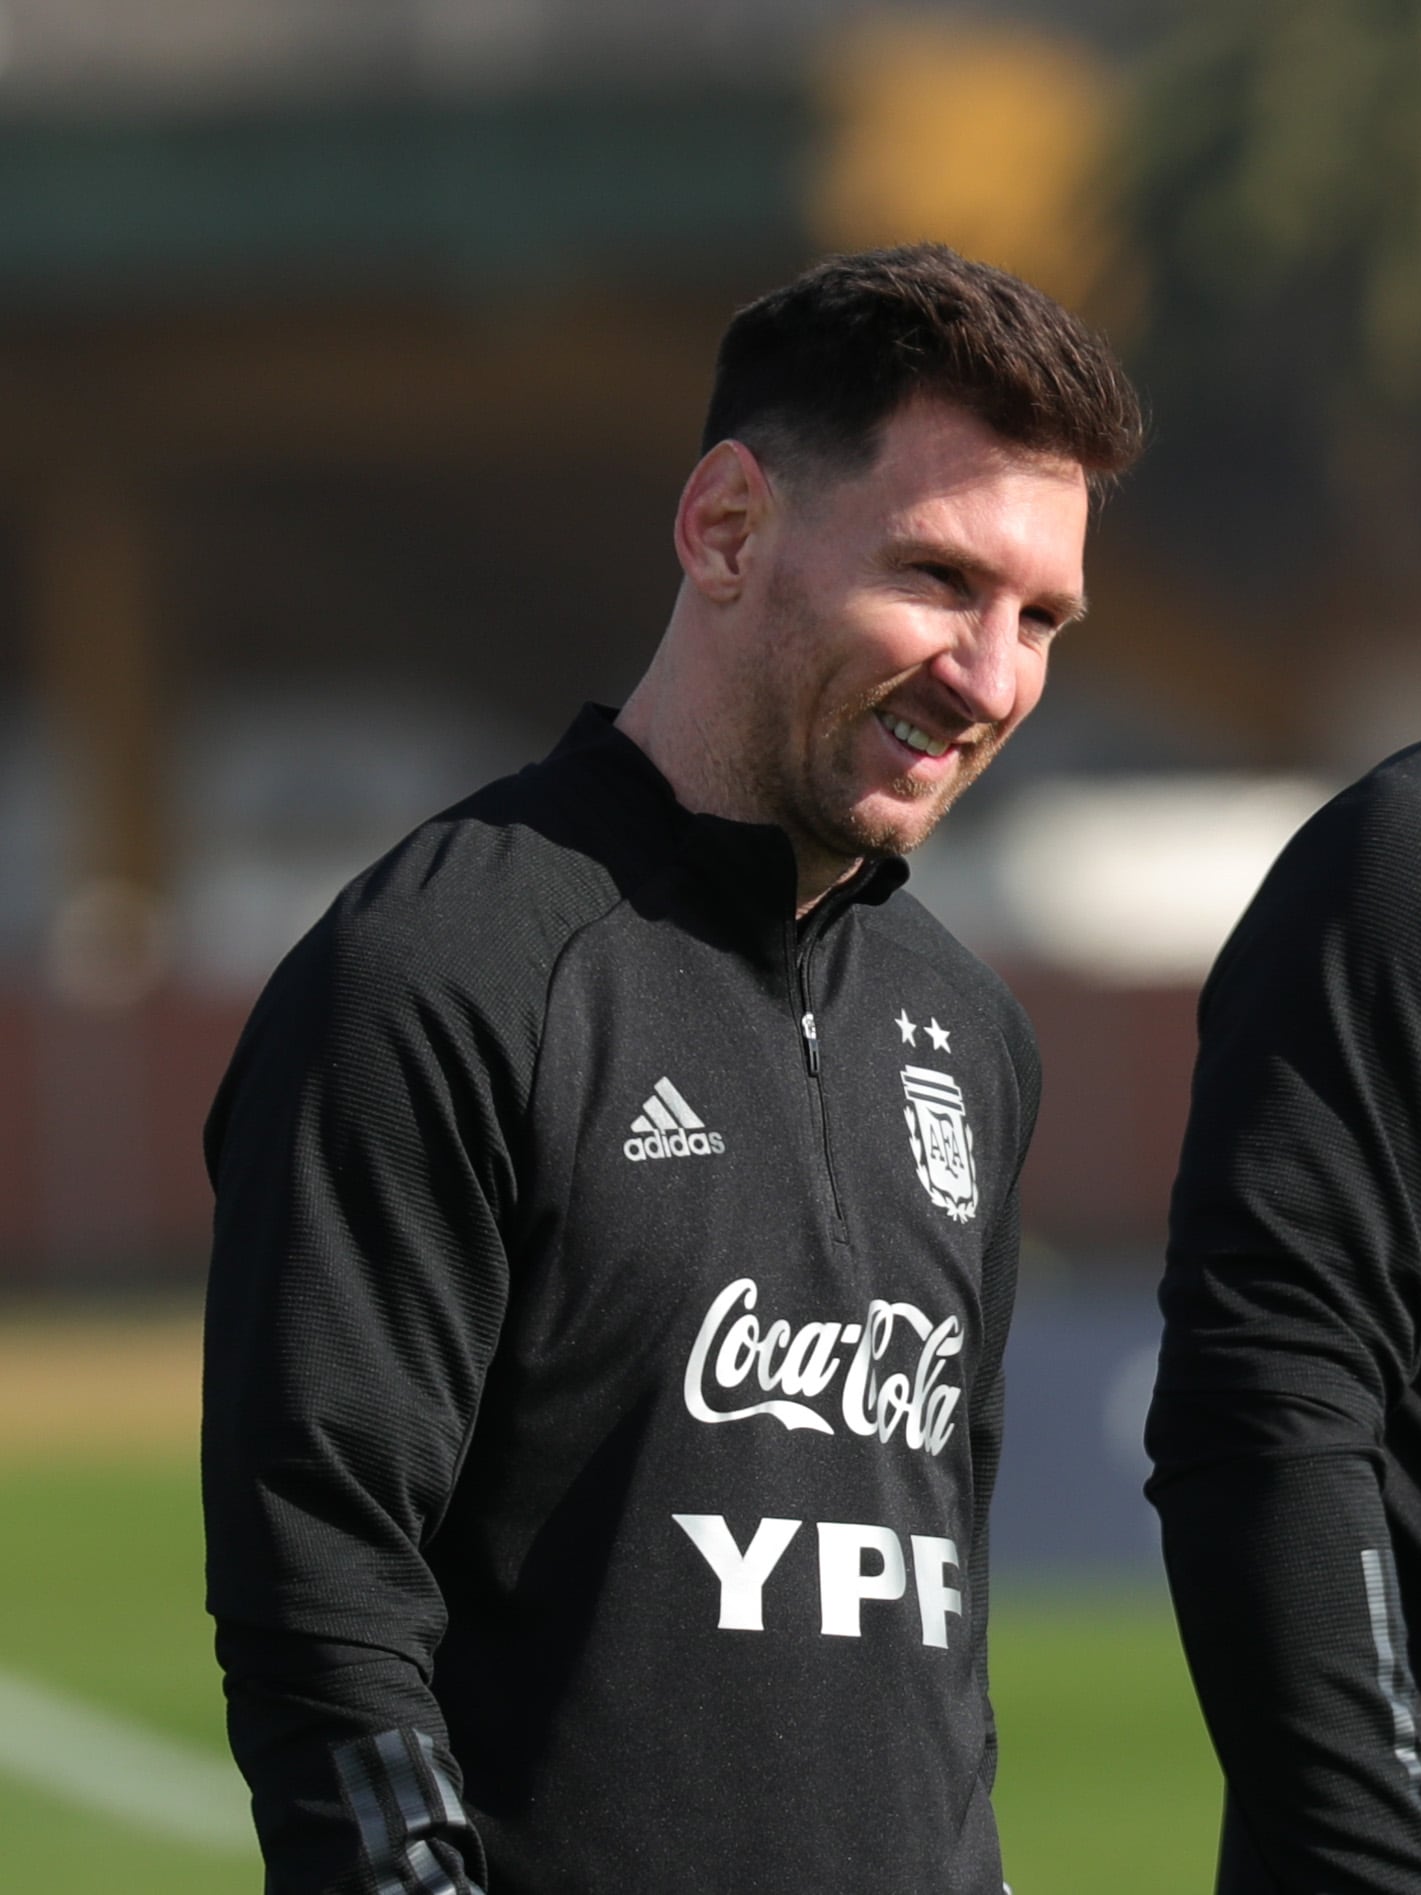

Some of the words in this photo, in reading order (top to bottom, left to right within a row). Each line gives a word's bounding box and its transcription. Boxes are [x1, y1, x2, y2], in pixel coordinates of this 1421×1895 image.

[622, 1126, 726, 1162] adidas
[683, 1277, 965, 1457] Coca-Cola
[671, 1513, 963, 1650] YPF
